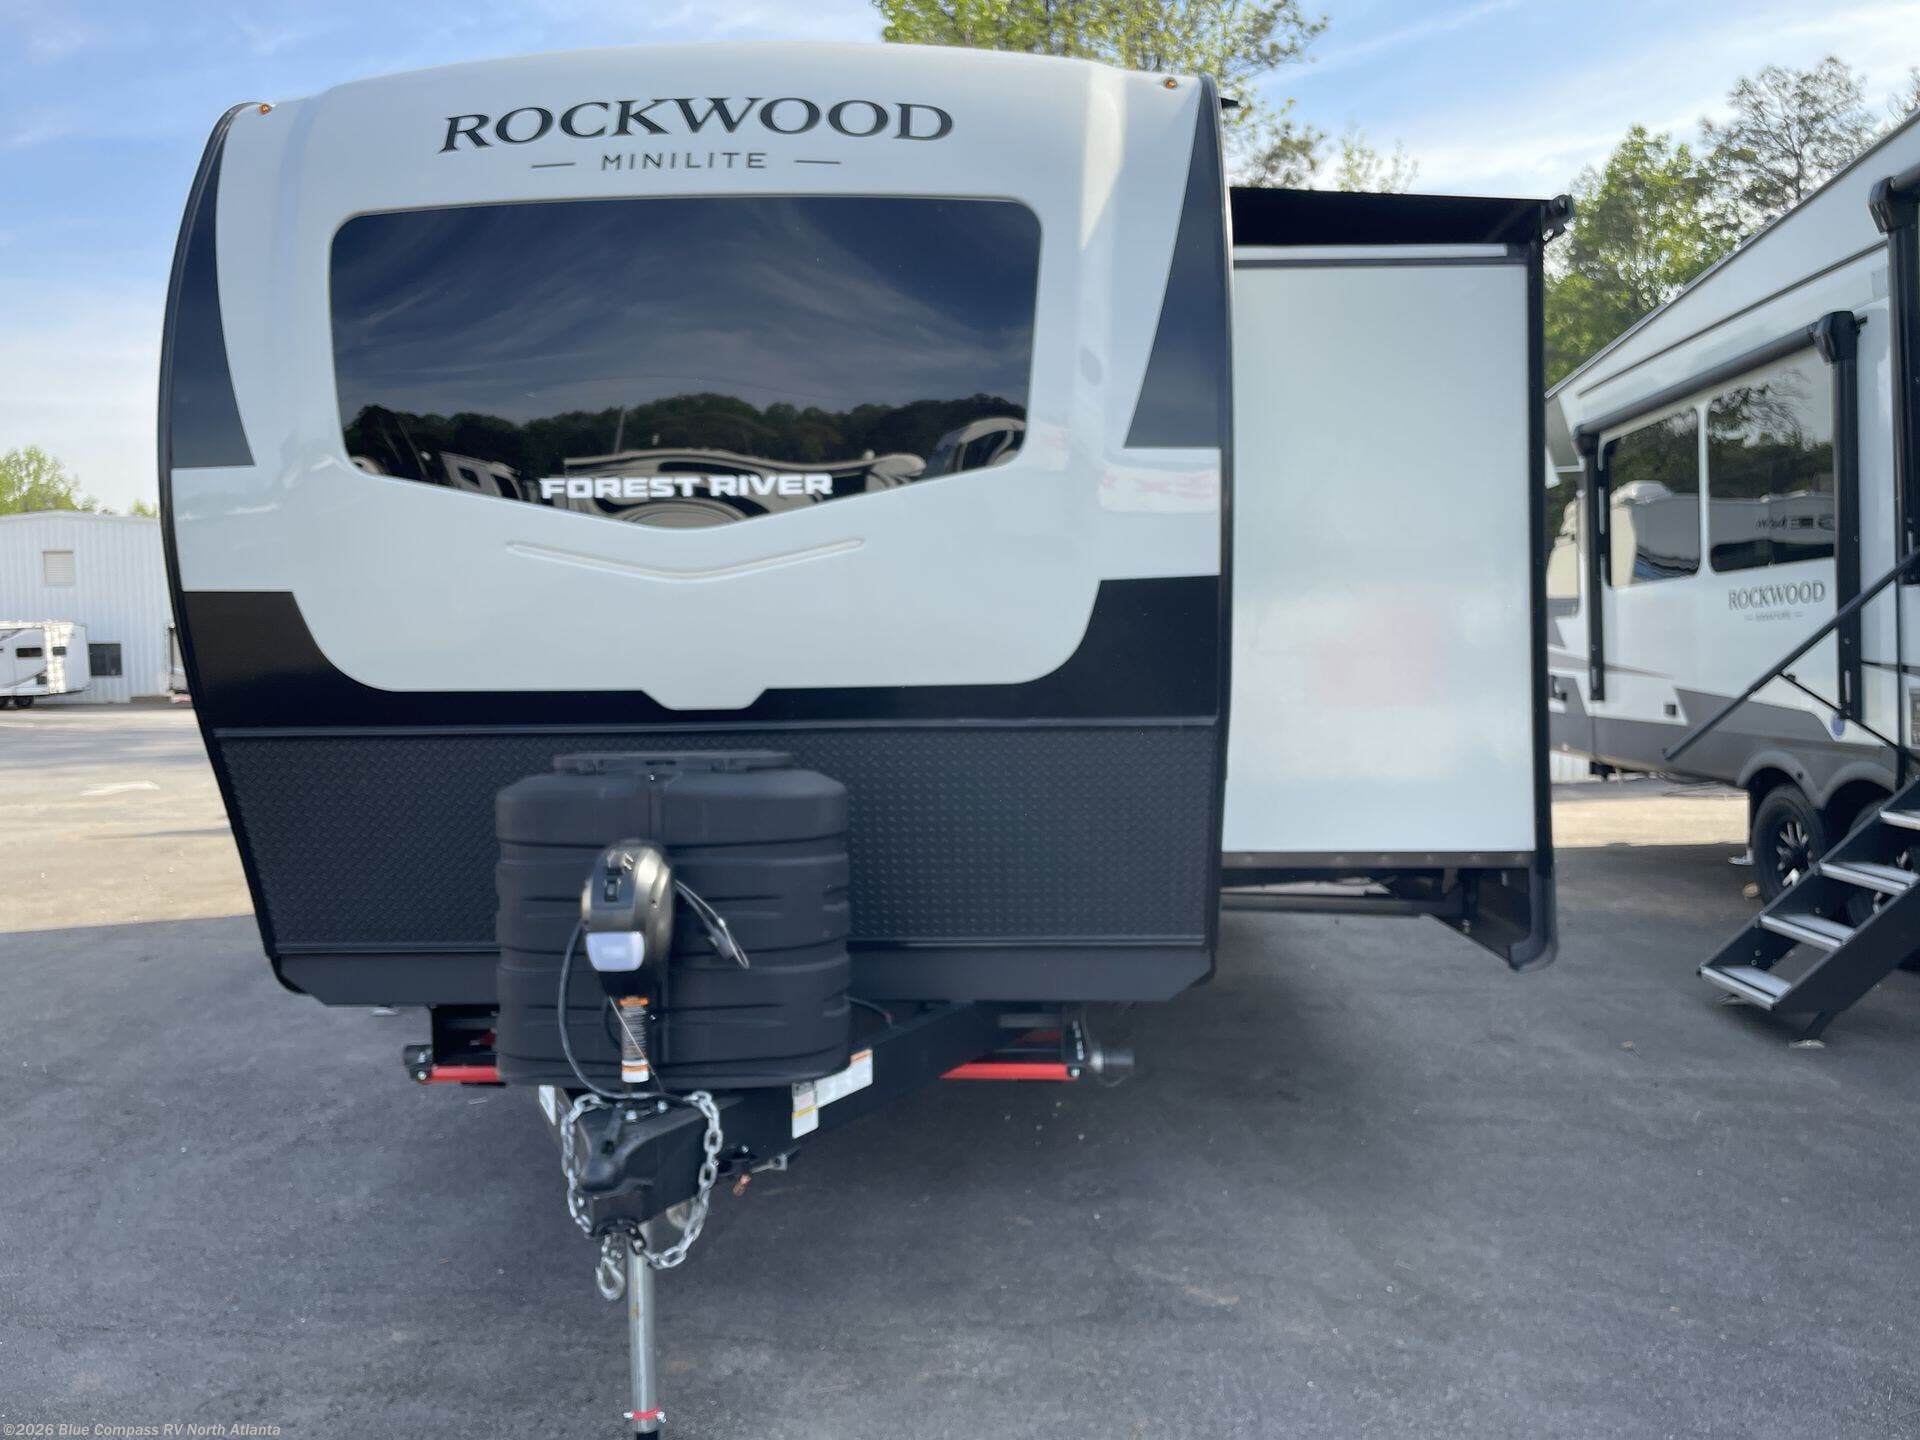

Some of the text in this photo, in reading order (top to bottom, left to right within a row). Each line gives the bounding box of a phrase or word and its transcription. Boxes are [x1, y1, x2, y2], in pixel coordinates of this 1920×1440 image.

[437, 96, 954, 154] ROCKWOOD
[601, 152, 766, 171] MINILITE
[539, 473, 833, 499] FOREST RIVER
[1728, 581, 1825, 611] ROCKWOOD
